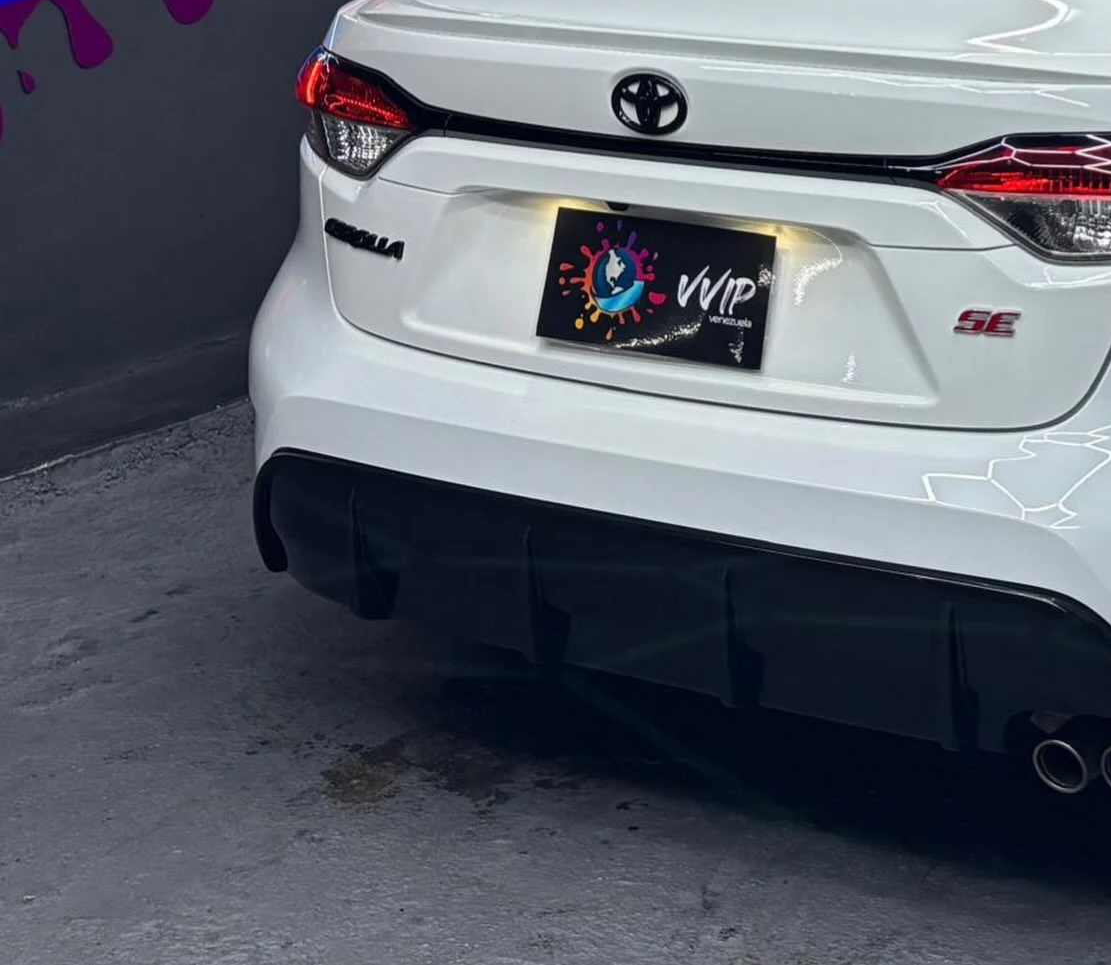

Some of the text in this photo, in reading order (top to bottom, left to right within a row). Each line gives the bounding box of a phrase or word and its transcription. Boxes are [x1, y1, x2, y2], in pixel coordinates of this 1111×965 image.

[677, 265, 757, 315] VVIP
[708, 314, 753, 329] venezuela
[953, 308, 1022, 338] SE
